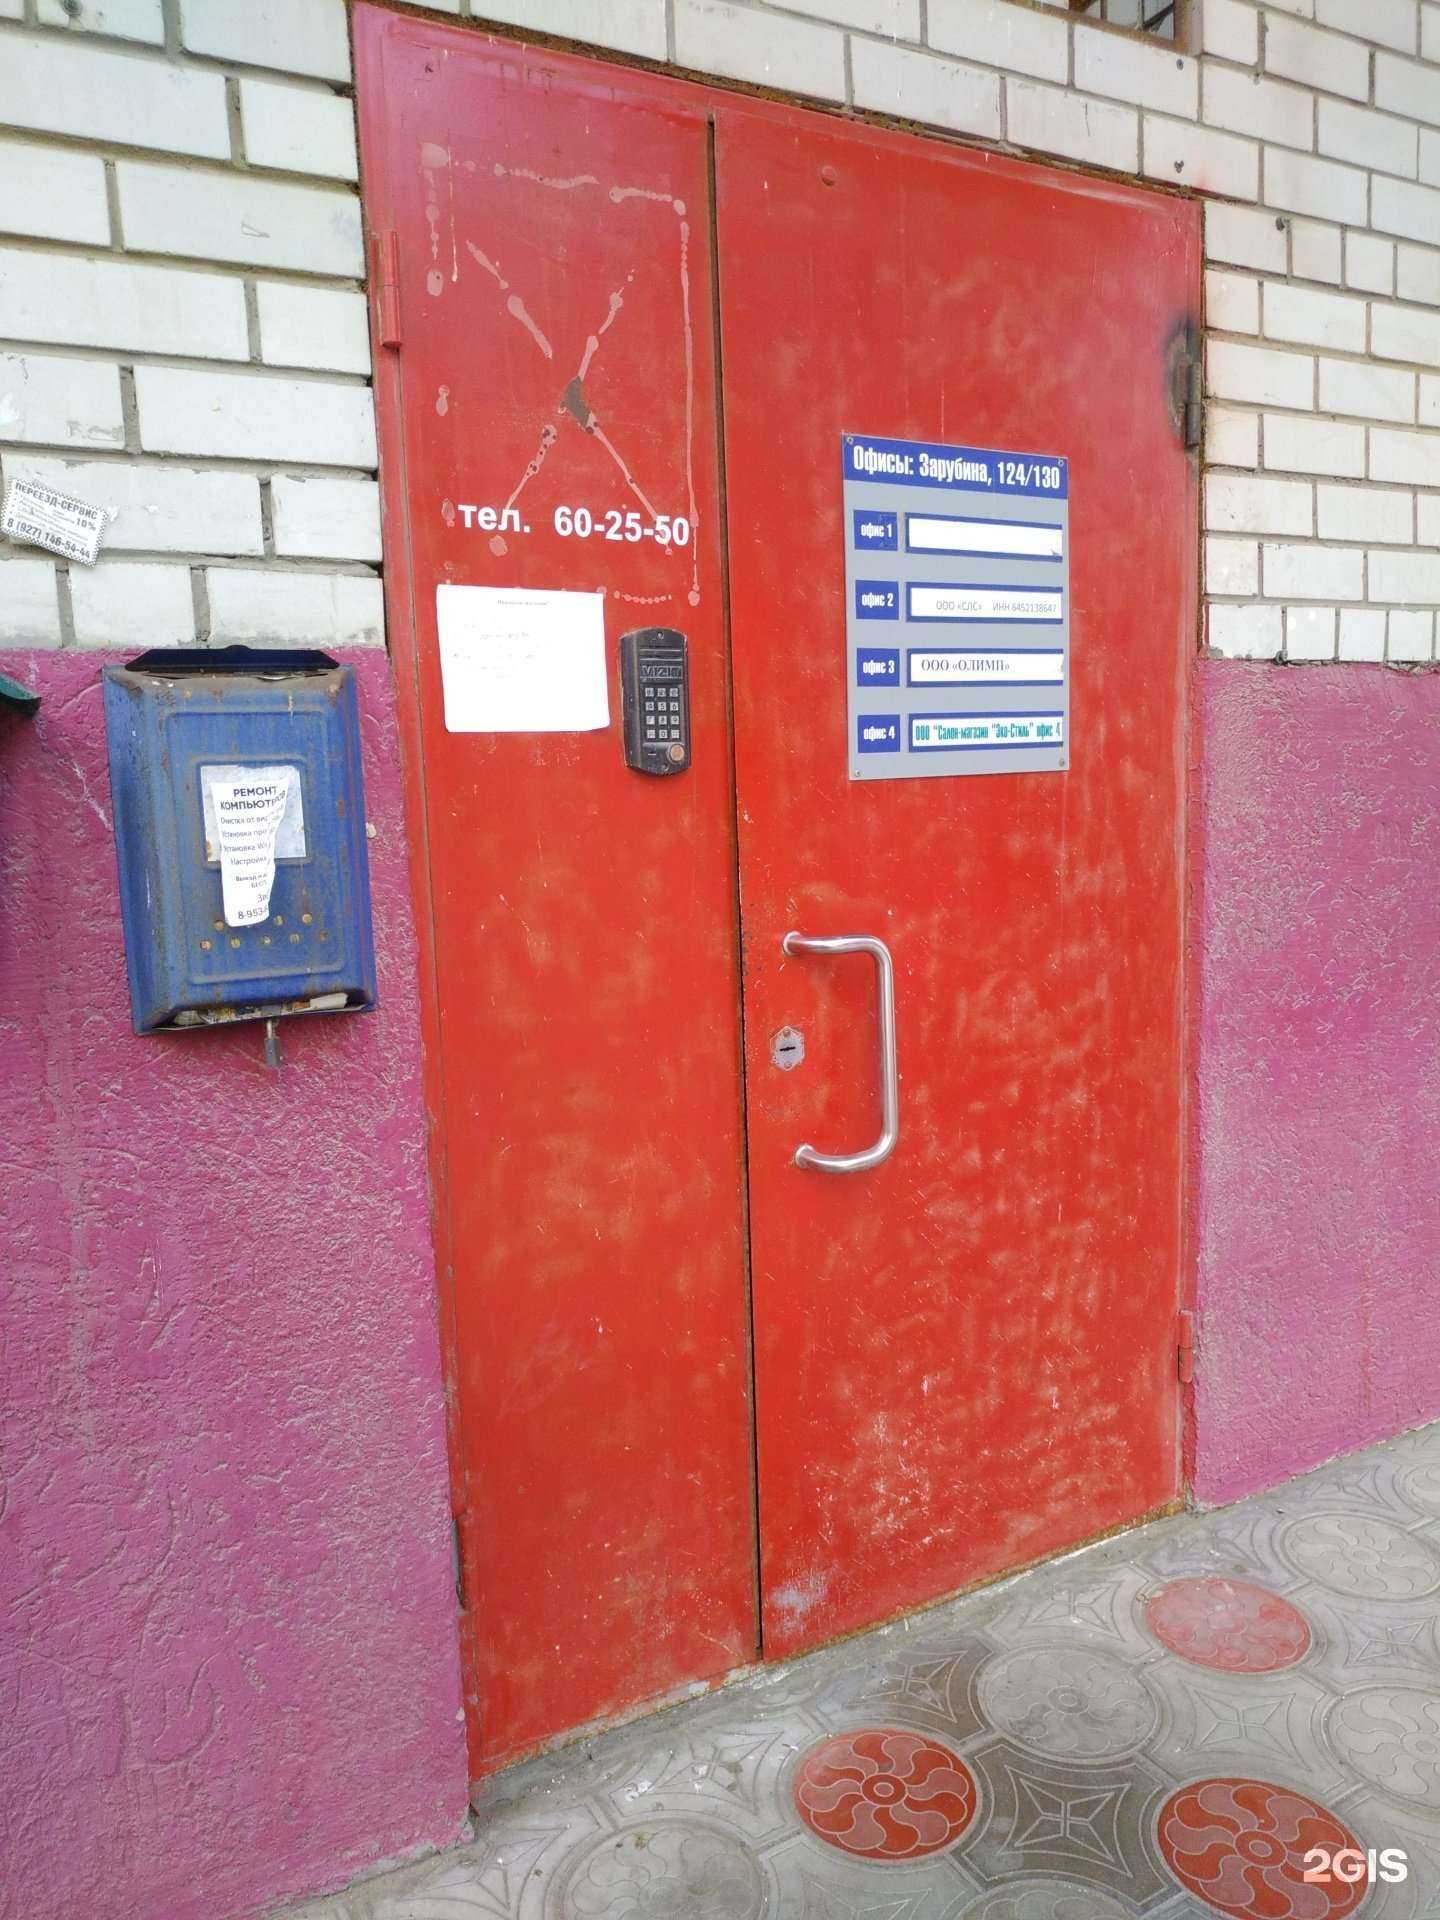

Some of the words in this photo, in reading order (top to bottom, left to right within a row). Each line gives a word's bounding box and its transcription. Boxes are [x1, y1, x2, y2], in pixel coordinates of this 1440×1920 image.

[853, 445, 914, 475] Офисы:
[919, 453, 992, 486] Зарубина,
[998, 462, 1060, 489] 124/130
[15, 482, 98, 520] ПЕРЕЕЗД-СЕРВИС
[7, 518, 14, 528] 8
[16, 521, 42, 539] (927)
[457, 503, 530, 533] тел.
[554, 506, 689, 546] 60-25-50
[861, 523, 885, 539] офис
[887, 524, 892, 538] 1
[861, 593, 885, 608] офис
[887, 593, 894, 607] 2
[862, 660, 887, 675] офис
[888, 660, 895, 673] 3
[921, 659, 949, 671] ООО
[952, 659, 1010, 671] «ОЛИМП»
[863, 726, 887, 742] офис
[888, 725, 895, 739] 4
[915, 725, 930, 740] ООО
[1036, 724, 1053, 740] офис
[233, 786, 277, 798] РЕМОНТ
